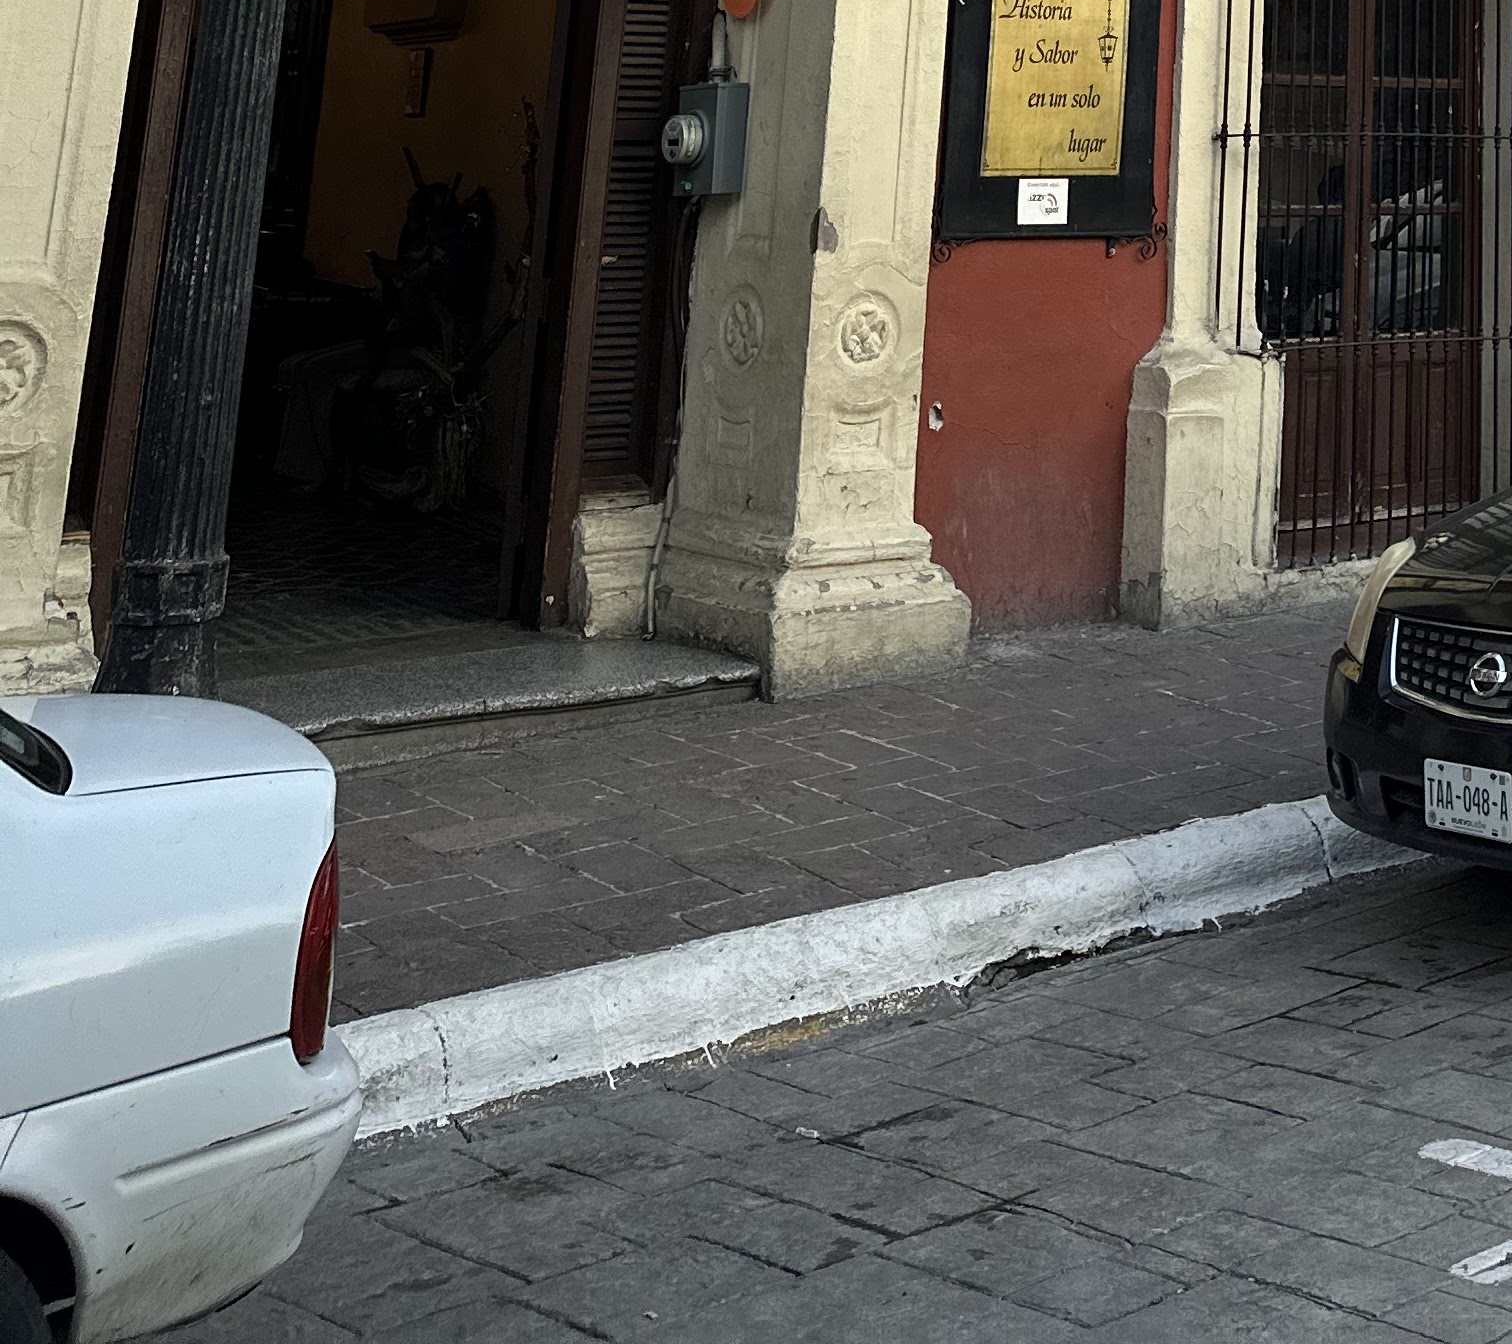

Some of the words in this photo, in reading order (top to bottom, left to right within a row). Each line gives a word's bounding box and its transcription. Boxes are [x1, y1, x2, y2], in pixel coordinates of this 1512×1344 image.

[1012, 47, 1025, 72] y
[1029, 39, 1078, 64] Sabor
[1028, 91, 1046, 108] en
[1049, 91, 1067, 108] un
[1071, 84, 1100, 108] solo
[1068, 128, 1107, 162] lugar
[1427, 777, 1509, 822] TAA-048-A
